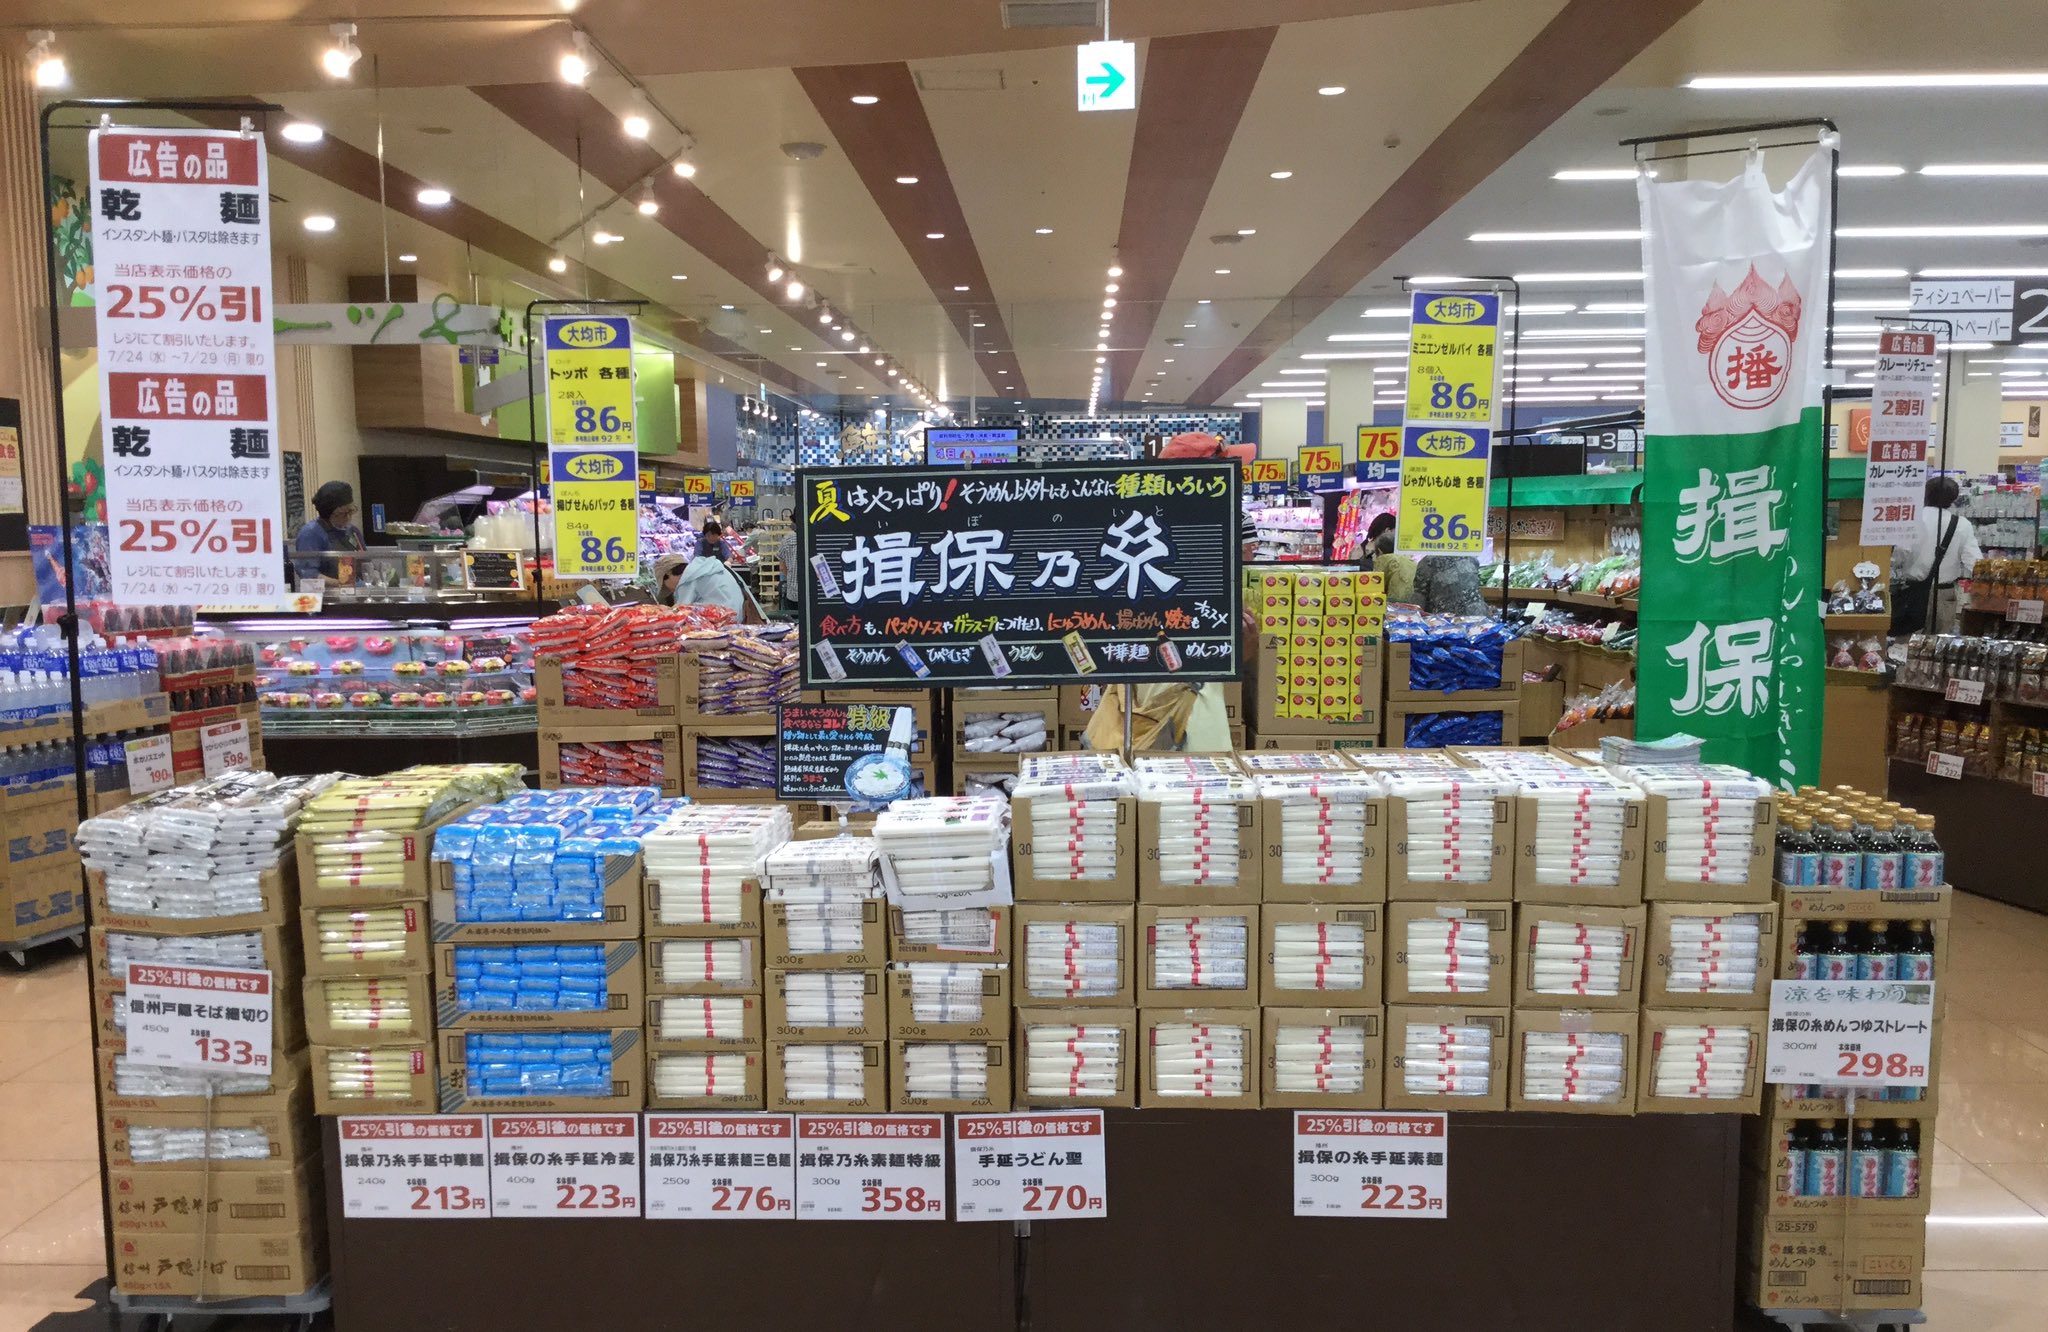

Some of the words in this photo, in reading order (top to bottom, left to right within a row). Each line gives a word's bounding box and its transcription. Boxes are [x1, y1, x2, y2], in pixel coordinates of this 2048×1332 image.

[127, 140, 229, 179] 広告の品
[101, 188, 141, 221] 乾
[220, 192, 260, 225] 麺
[102, 229, 261, 246] インスタント麺・パスタは除きます
[114, 263, 232, 280] 当店表示価格の
[106, 284, 262, 323] 25%引
[1912, 287, 2012, 306] ティシュペーパー
[1434, 301, 1476, 318] 大均市
[112, 332, 257, 349] レジにて割引いたします。
[567, 325, 607, 343] 大均市
[1477, 343, 1493, 356] 各種
[1891, 336, 1925, 353] 広告の品
[550, 366, 588, 380] トッポ
[599, 366, 630, 380] 各種
[1726, 343, 1783, 390] 播
[1878, 357, 1934, 372] カレー・シチュー
[137, 378, 239, 416] 広告の品
[1881, 400, 1925, 416] 2割引
[112, 426, 151, 458] 乾
[230, 427, 270, 459] 麺
[1361, 432, 1400, 459] 75
[1425, 434, 1466, 452] 大均市
[1600, 432, 1617, 450] 3
[1881, 443, 1918, 459] 広告の品
[575, 459, 615, 475] 大均市
[1301, 450, 1341, 472] 75円
[113, 464, 271, 480] インスタント麺・パスタは除きます
[1254, 463, 1286, 481] 75円
[1367, 462, 1401, 480] 均一
[1869, 464, 1925, 479] カレー・シチュー
[1258, 483, 1282, 494] 均一
[1306, 474, 1336, 489] 均一
[1466, 476, 1485, 489] 各種
[126, 498, 243, 513] 当店表示価格の
[620, 498, 635, 511] 各種
[1411, 497, 1433, 506] 58g
[1872, 505, 1915, 522] 2割引
[566, 522, 589, 531] 84g
[119, 518, 272, 554] 25%引
[126, 565, 268, 580] レジにて割引いたします。
[845, 647, 892, 664] そうめん
[925, 646, 976, 664] ひやむぎ
[1008, 645, 1044, 660] うどん
[1101, 643, 1150, 662] 中華麺
[1185, 641, 1233, 658] めんつゆ
[776, 955, 804, 965] 300g
[846, 954, 869, 964] 20入
[137, 968, 261, 991] 25%引後の価格です
[1784, 985, 1907, 1003] 涼を味わう
[899, 1026, 927, 1036] 300g
[969, 1027, 992, 1036] 20入
[194, 1037, 268, 1067] 133円
[1782, 1042, 1818, 1050] 300ml
[1837, 1052, 1925, 1077] 298円
[351, 1122, 475, 1137] 25%引後の価格です
[501, 1120, 626, 1136] 25%引後の価格です
[658, 1121, 782, 1136] 25%引後の価格です
[808, 1120, 933, 1136] 25%引後の価格です
[967, 1119, 1093, 1136] 25%引後の価格です
[1306, 1118, 1435, 1135] 25%引後の価格です
[494, 1152, 636, 1167] 揖保の糸手延冷麦
[978, 1151, 1083, 1168] 手延うどん聖
[1297, 1149, 1444, 1166] 揖保の糸手延素麺
[358, 1177, 386, 1186] 240g
[506, 1176, 536, 1185] 400g
[662, 1176, 690, 1186] 250g
[812, 1176, 841, 1186] 300g
[971, 1178, 1001, 1187] 300g
[1310, 1174, 1340, 1183] 300g
[411, 1185, 486, 1211] 213円
[556, 1184, 636, 1210] 223円
[711, 1186, 792, 1212] 276円
[861, 1186, 942, 1213] 358円
[1022, 1184, 1103, 1212] 270円
[1361, 1183, 1443, 1210] 223円
[1777, 1222, 1816, 1233] 25-579
